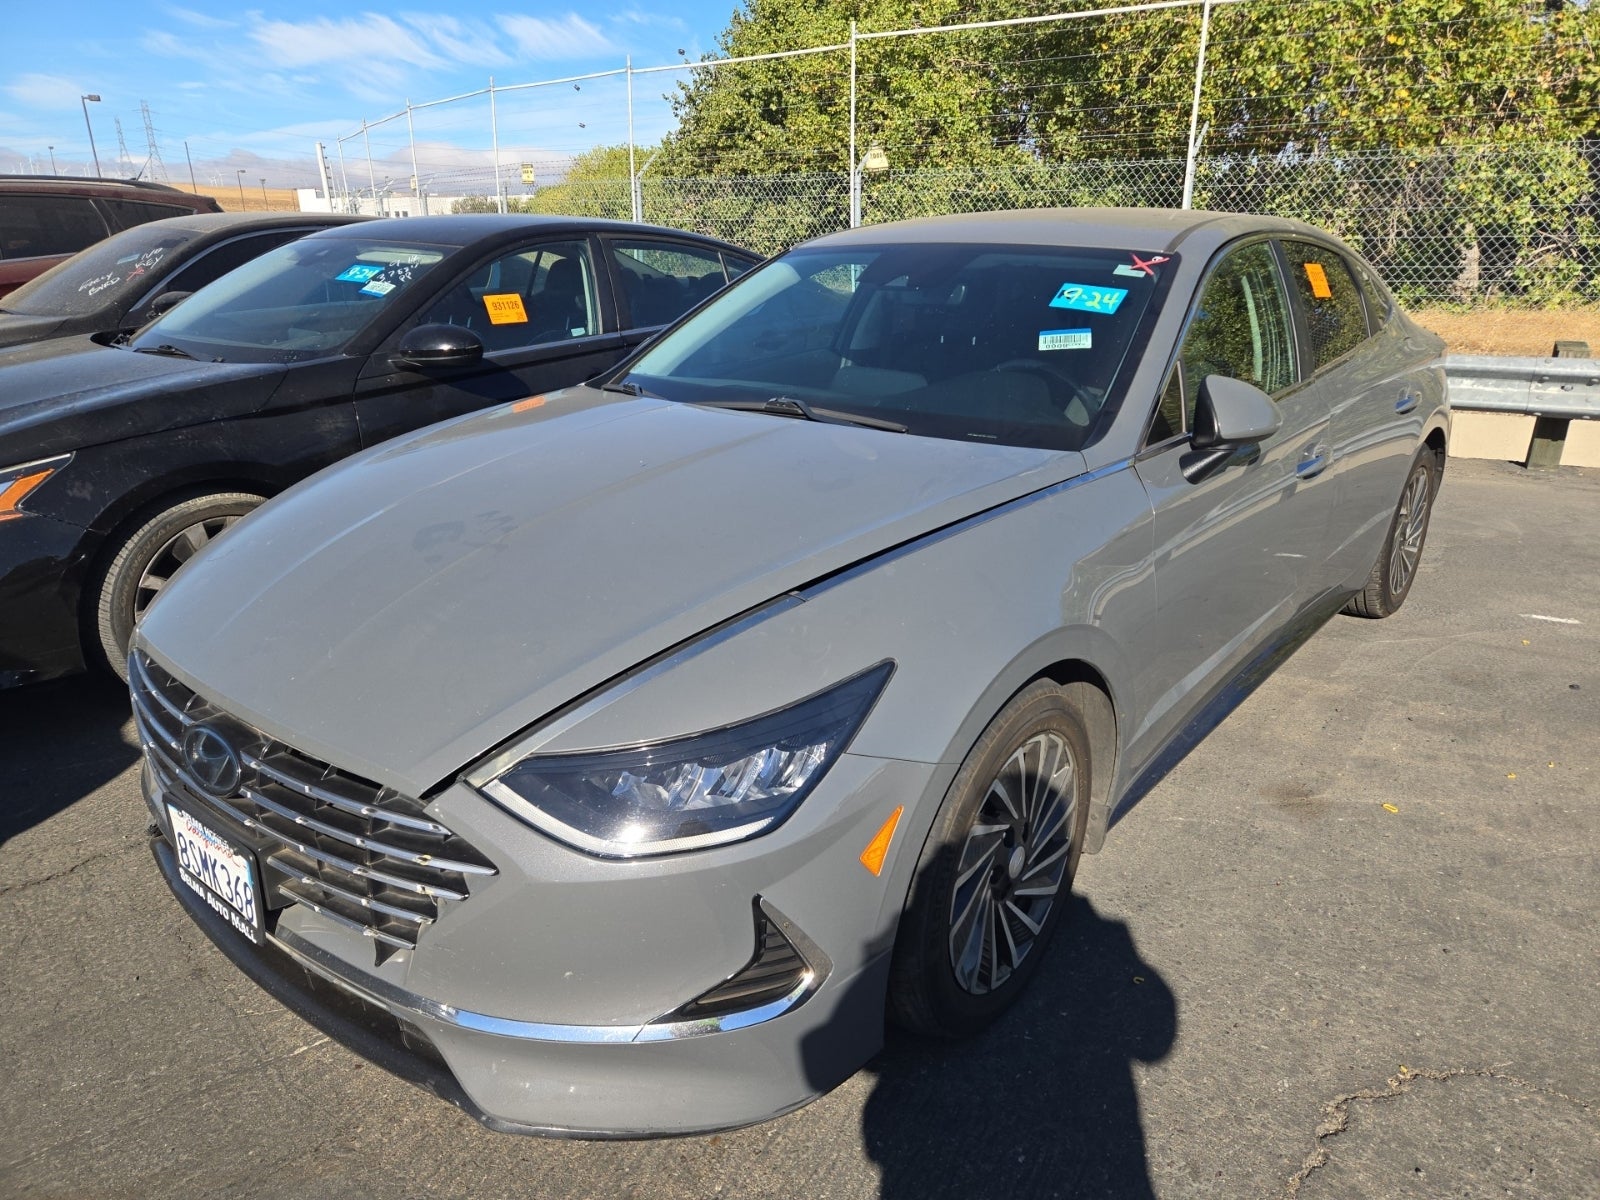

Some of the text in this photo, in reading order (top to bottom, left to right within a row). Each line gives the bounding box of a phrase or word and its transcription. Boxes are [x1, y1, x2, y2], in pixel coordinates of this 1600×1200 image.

[1063, 287, 1120, 311] 9-24
[177, 831, 255, 924] 8SMK368
[179, 866, 258, 945] SELMA AUTO MALL
